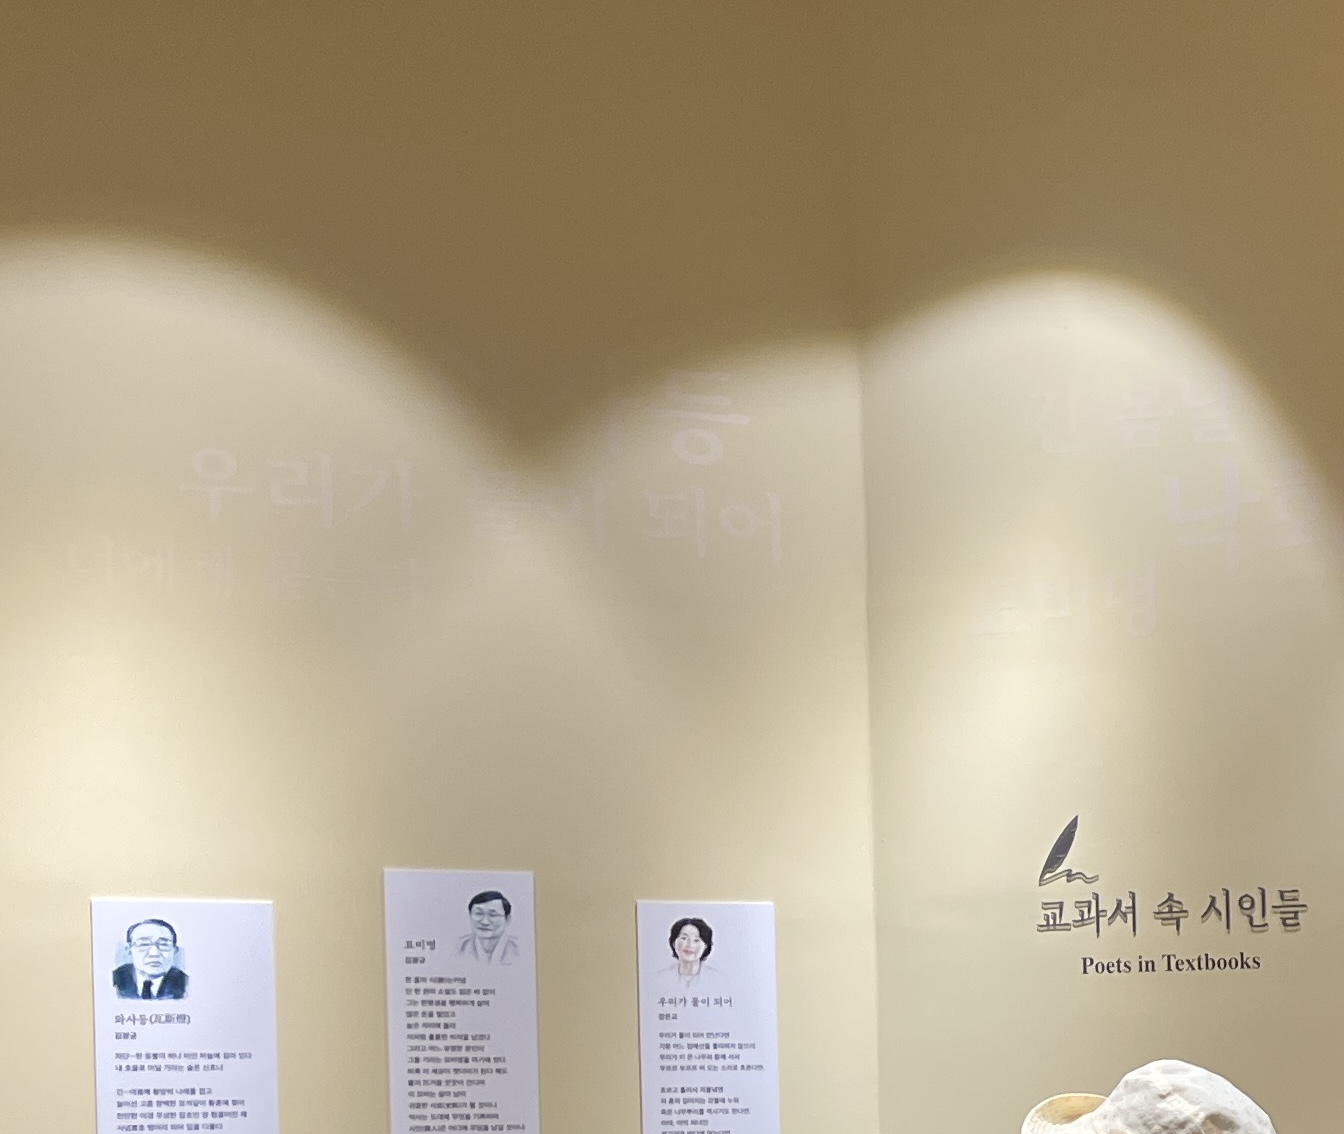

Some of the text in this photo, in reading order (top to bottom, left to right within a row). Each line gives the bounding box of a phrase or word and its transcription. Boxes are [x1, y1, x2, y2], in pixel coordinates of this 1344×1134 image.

[1037, 887, 1308, 938] 교과서 속 시인들
[1081, 952, 1261, 975] Poets in Textbooks
[658, 997, 687, 1007] 우리가
